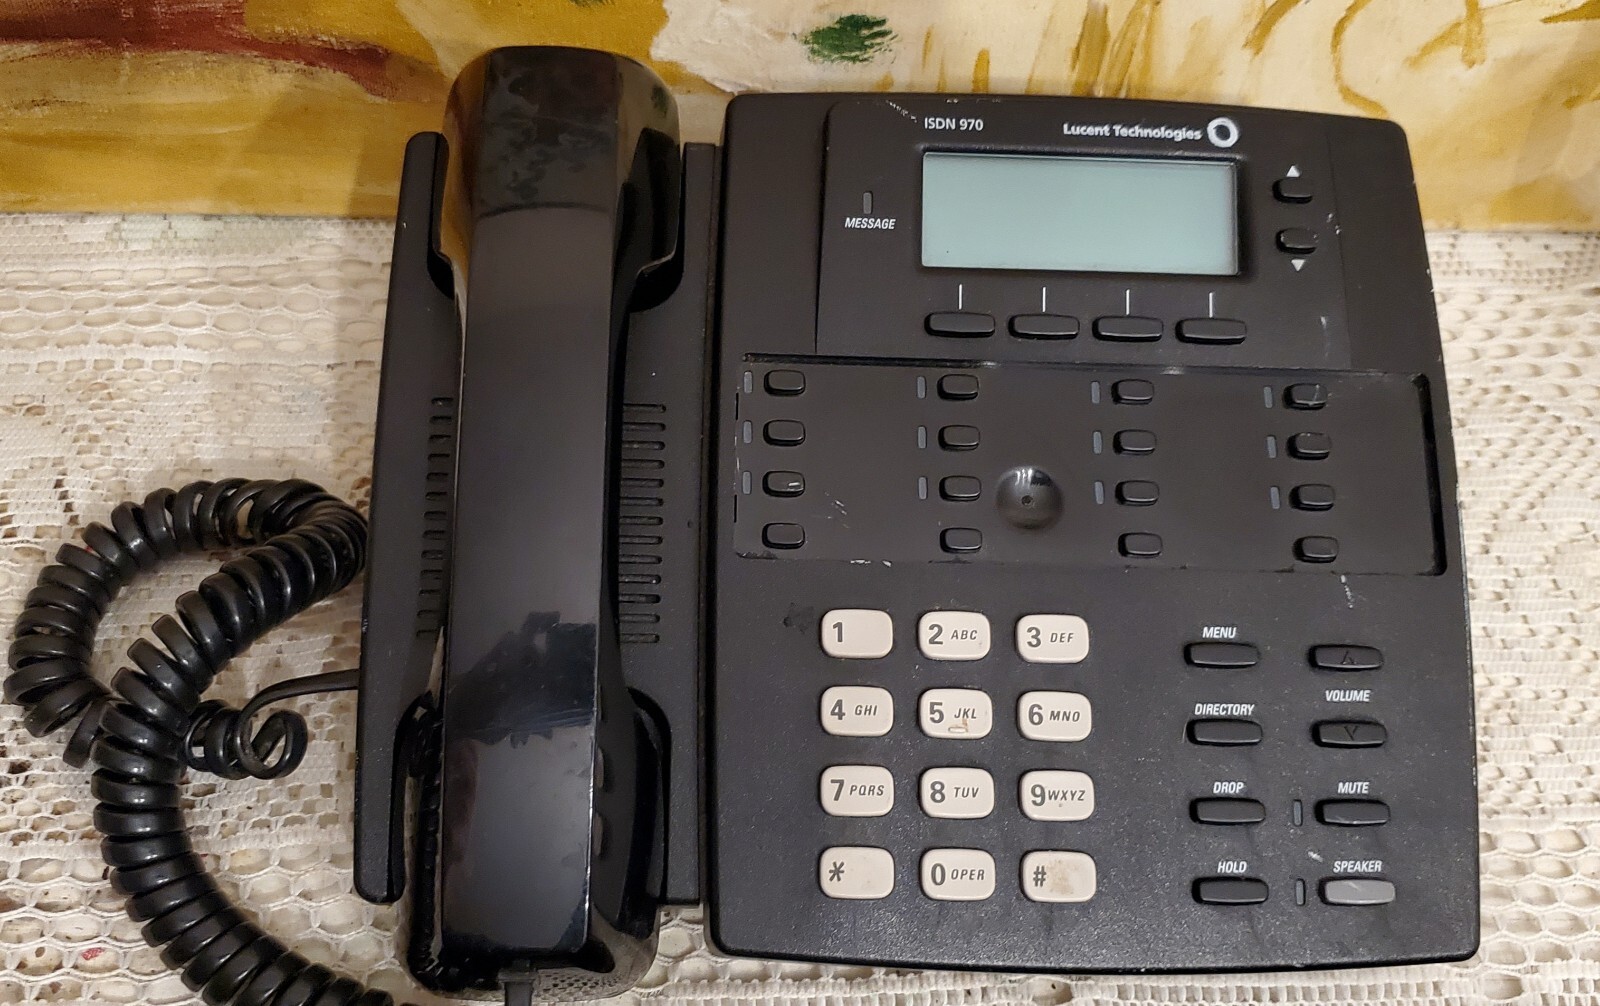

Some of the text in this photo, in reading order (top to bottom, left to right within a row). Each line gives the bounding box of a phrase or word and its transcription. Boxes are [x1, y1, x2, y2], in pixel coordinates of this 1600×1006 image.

[924, 117, 983, 132] ISDN 970
[1063, 123, 1202, 142] Lucent Technologies
[844, 217, 895, 230] MESSAGE
[832, 622, 843, 642] 1
[928, 624, 978, 645] 2 ABC
[1026, 627, 1074, 647] 3 DEF
[1202, 627, 1236, 638] MENU
[1325, 690, 1370, 701] VOLUME
[830, 699, 878, 720] 4 GHI
[929, 702, 977, 723] 5 JKL
[1028, 704, 1080, 725] 6 MNO
[1194, 704, 1254, 715] DIRECTORY
[830, 779, 885, 801] 7 PQRS
[930, 781, 979, 803] 8 TUV
[1030, 784, 1085, 806] 9 WXYZ
[1213, 782, 1244, 794] DROP
[1338, 782, 1369, 794] MUTE
[931, 863, 985, 885] 0 OPER
[1218, 861, 1247, 873] HOLD
[1333, 860, 1382, 872] SPEAKER
[1033, 866, 1046, 887] #
